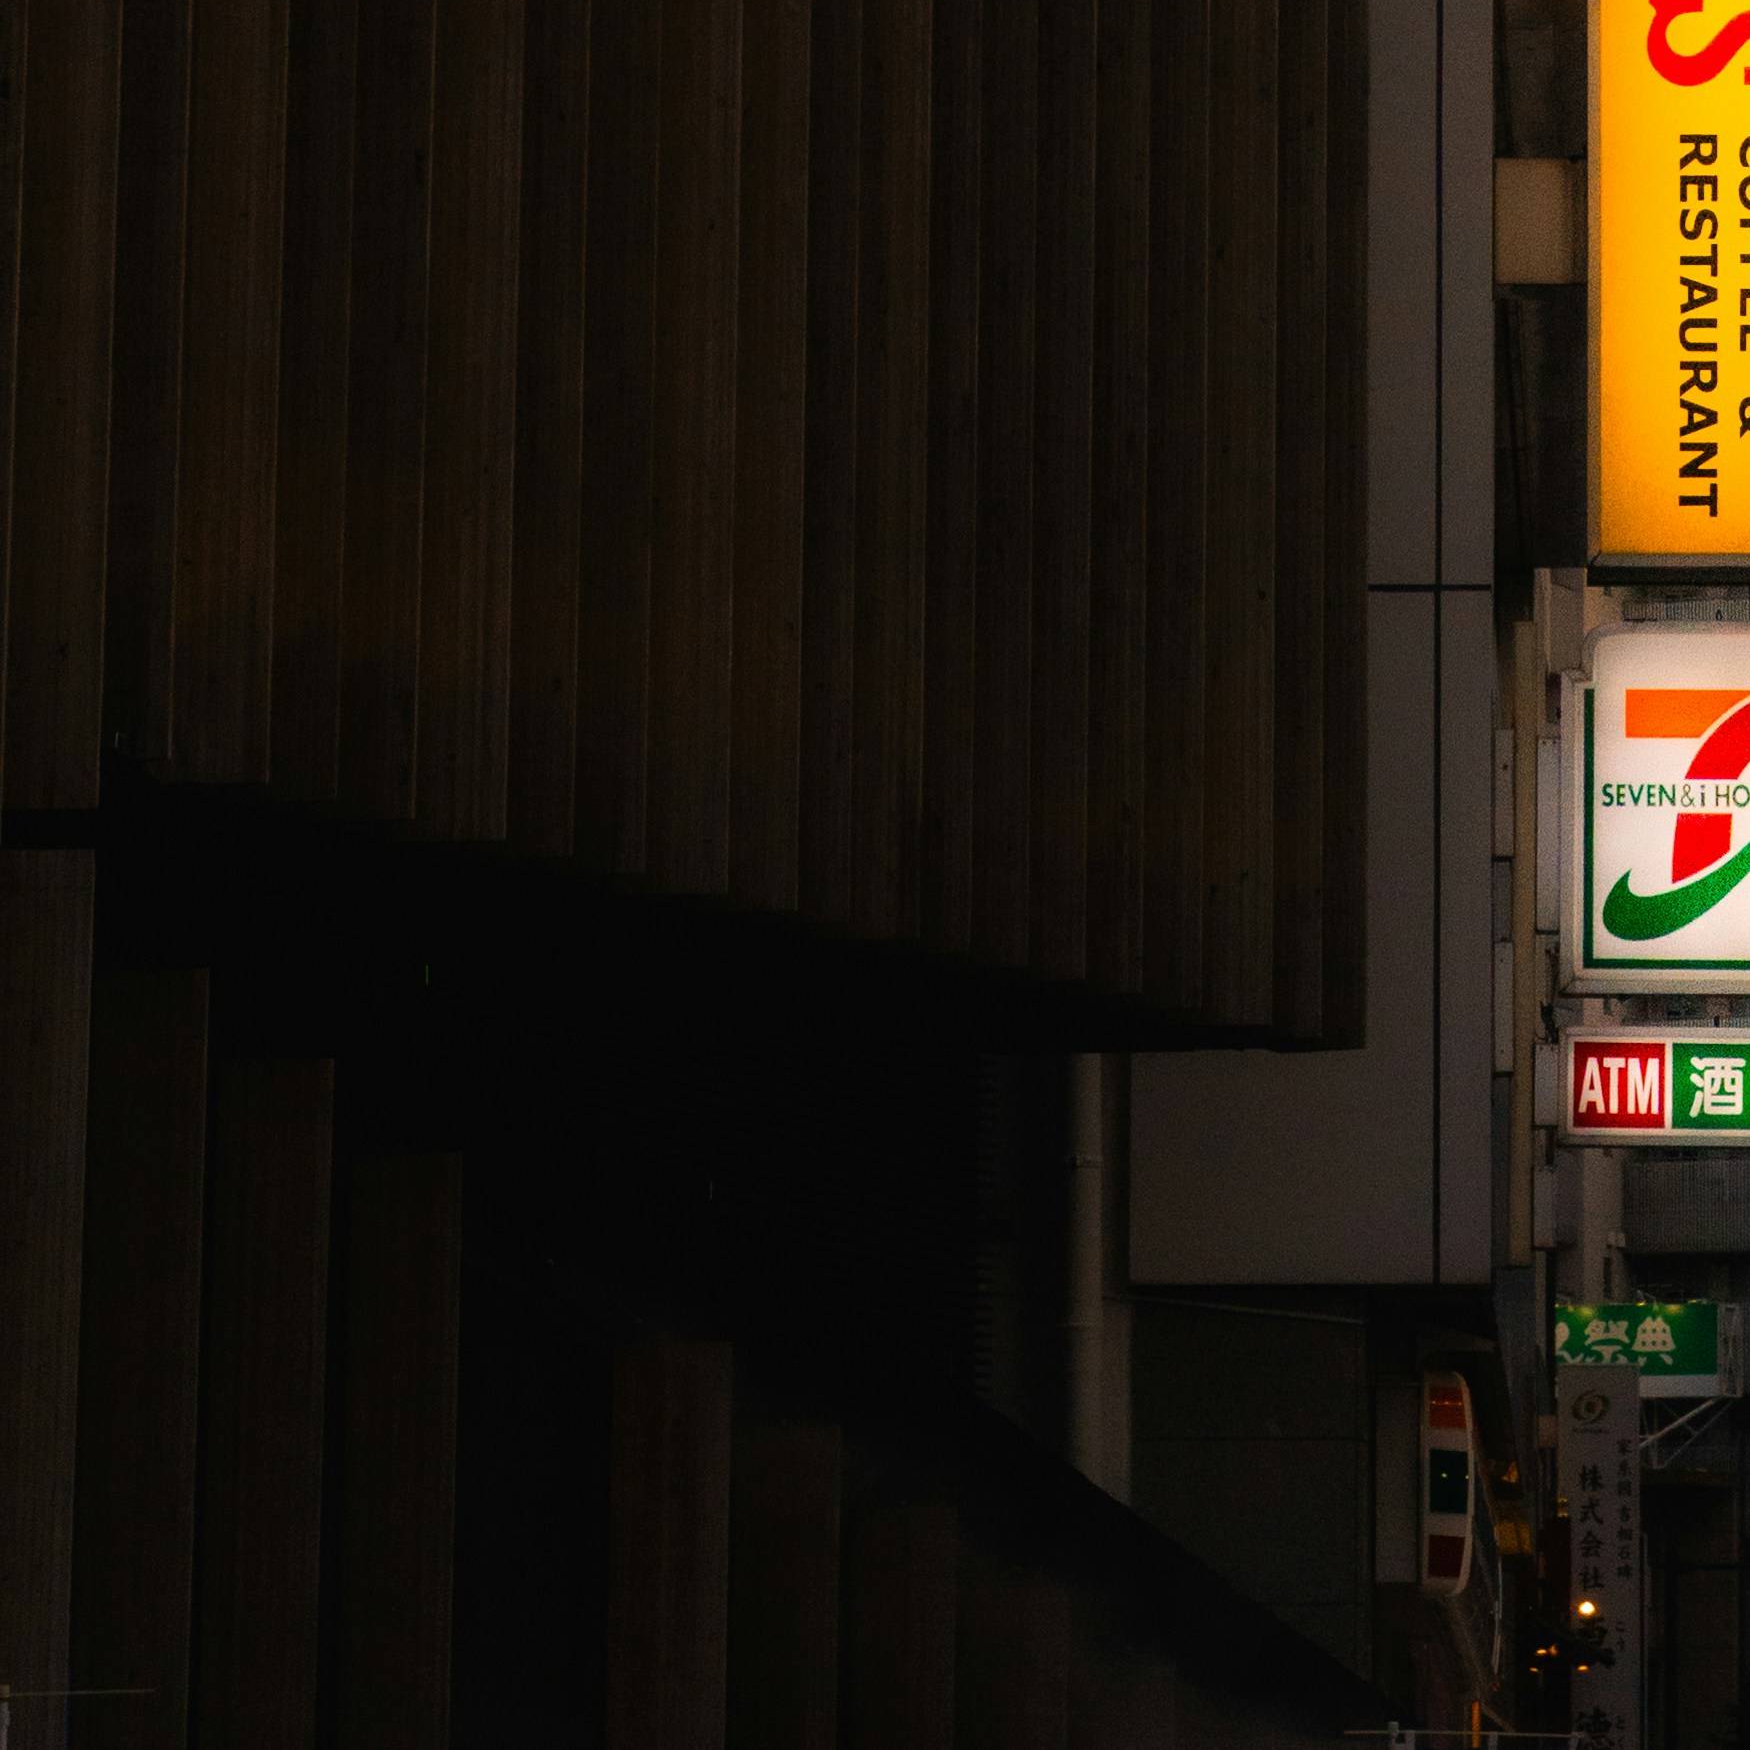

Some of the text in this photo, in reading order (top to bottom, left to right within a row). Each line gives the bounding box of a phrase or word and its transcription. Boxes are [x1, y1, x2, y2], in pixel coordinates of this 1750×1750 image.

[1678, 134, 1719, 518] RESTAURANT
[1579, 1056, 1659, 1115] ATM
[1689, 1056, 1746, 1117] 酒
[1578, 1463, 1605, 1592] 株式会社
